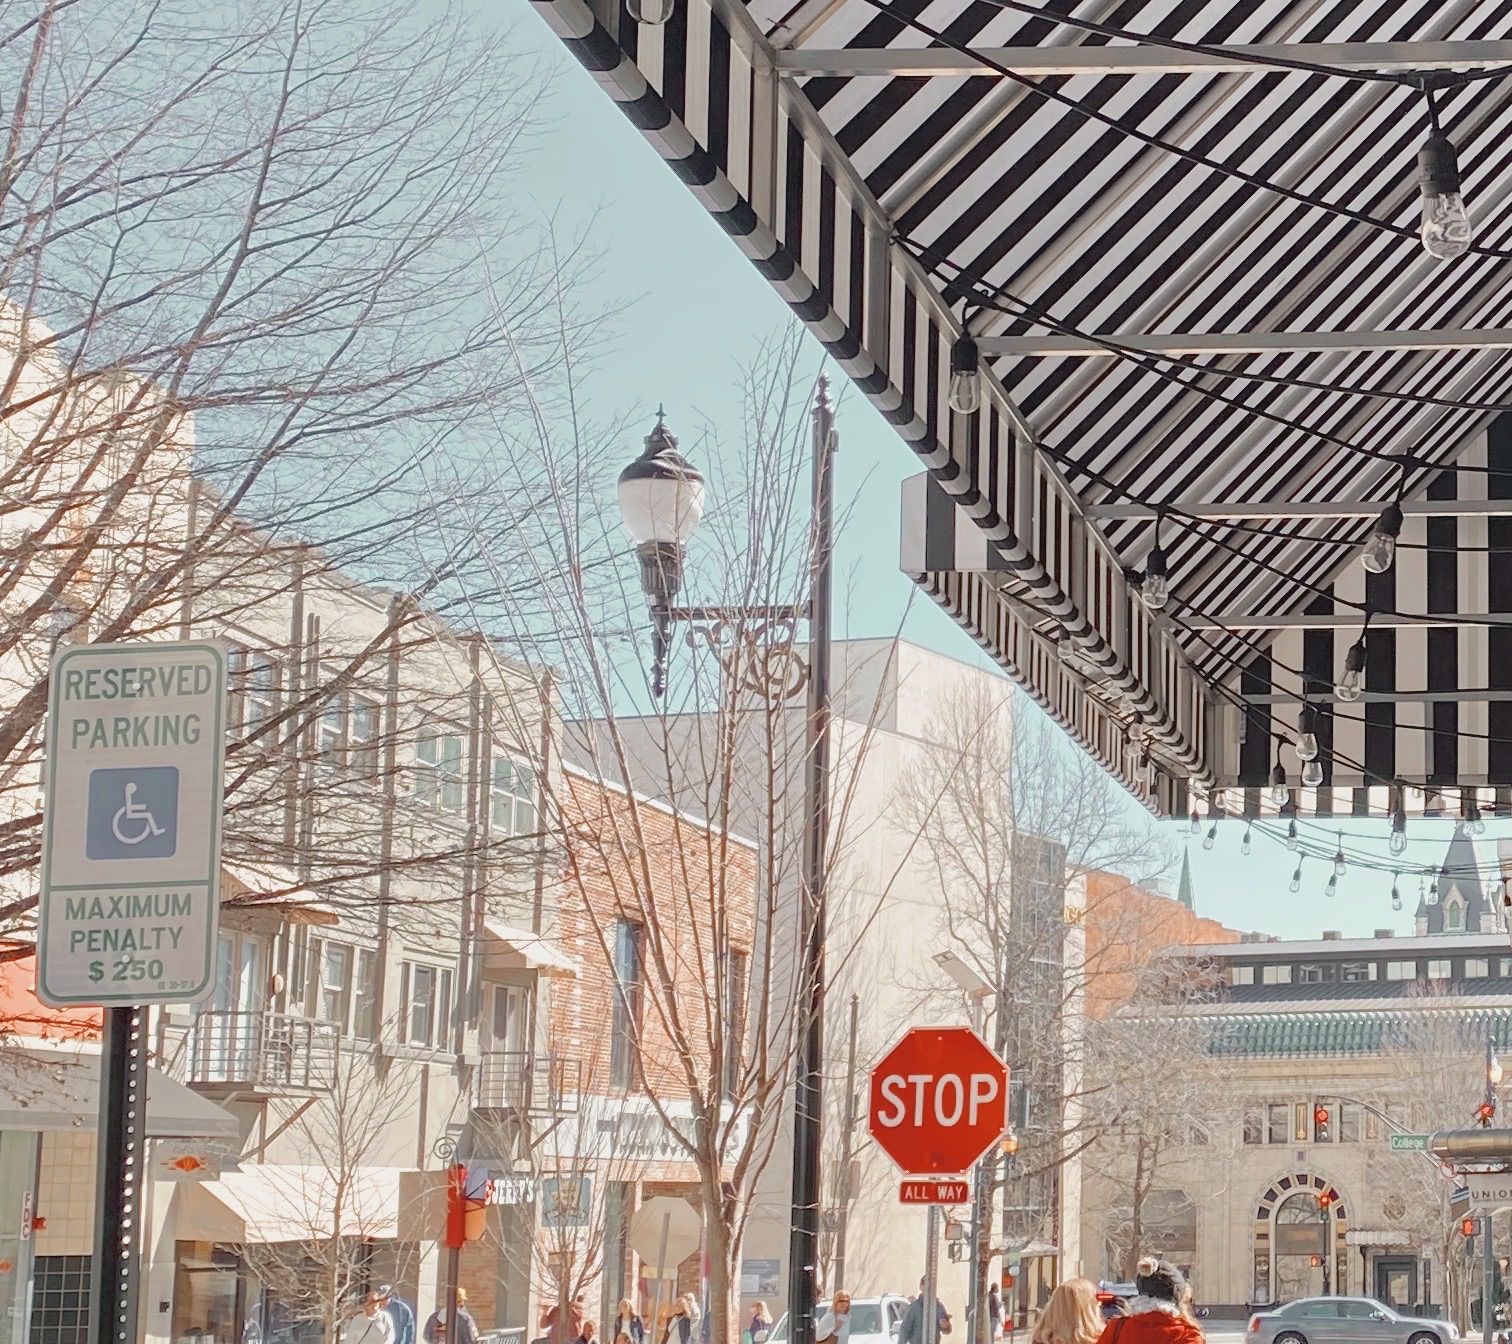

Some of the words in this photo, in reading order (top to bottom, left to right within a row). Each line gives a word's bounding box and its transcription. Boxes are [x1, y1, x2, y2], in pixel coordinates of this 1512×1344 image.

[65, 664, 211, 701] RESERVED
[71, 713, 200, 749] PARKING
[65, 893, 192, 921] MAXIMUM
[70, 926, 183, 953] PENALTY
[112, 959, 164, 981] 250
[877, 1073, 999, 1128] STOP
[1392, 1136, 1424, 1150] College
[904, 1186, 930, 1200] ALL
[938, 1186, 964, 1200] WAY
